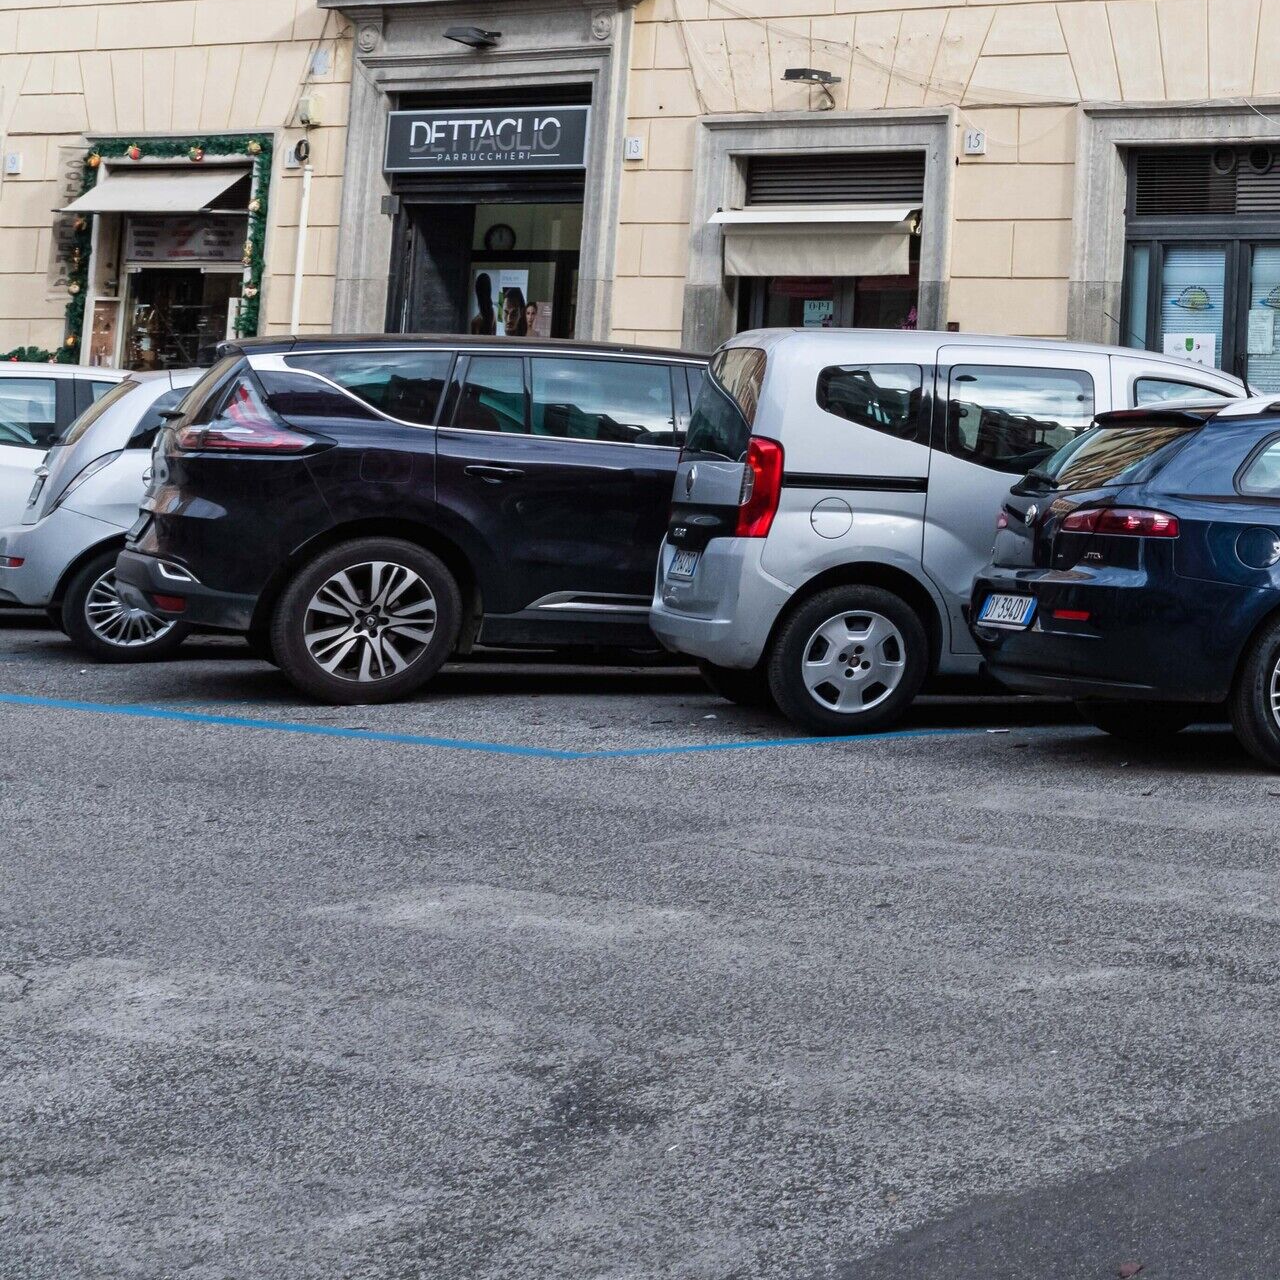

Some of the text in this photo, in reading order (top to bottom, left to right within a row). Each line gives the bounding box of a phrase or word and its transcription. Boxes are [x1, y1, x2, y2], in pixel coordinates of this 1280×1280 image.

[409, 117, 562, 153] DETTAGLIO
[967, 133, 980, 148] 15
[436, 151, 531, 162] PARRUCCHIERI
